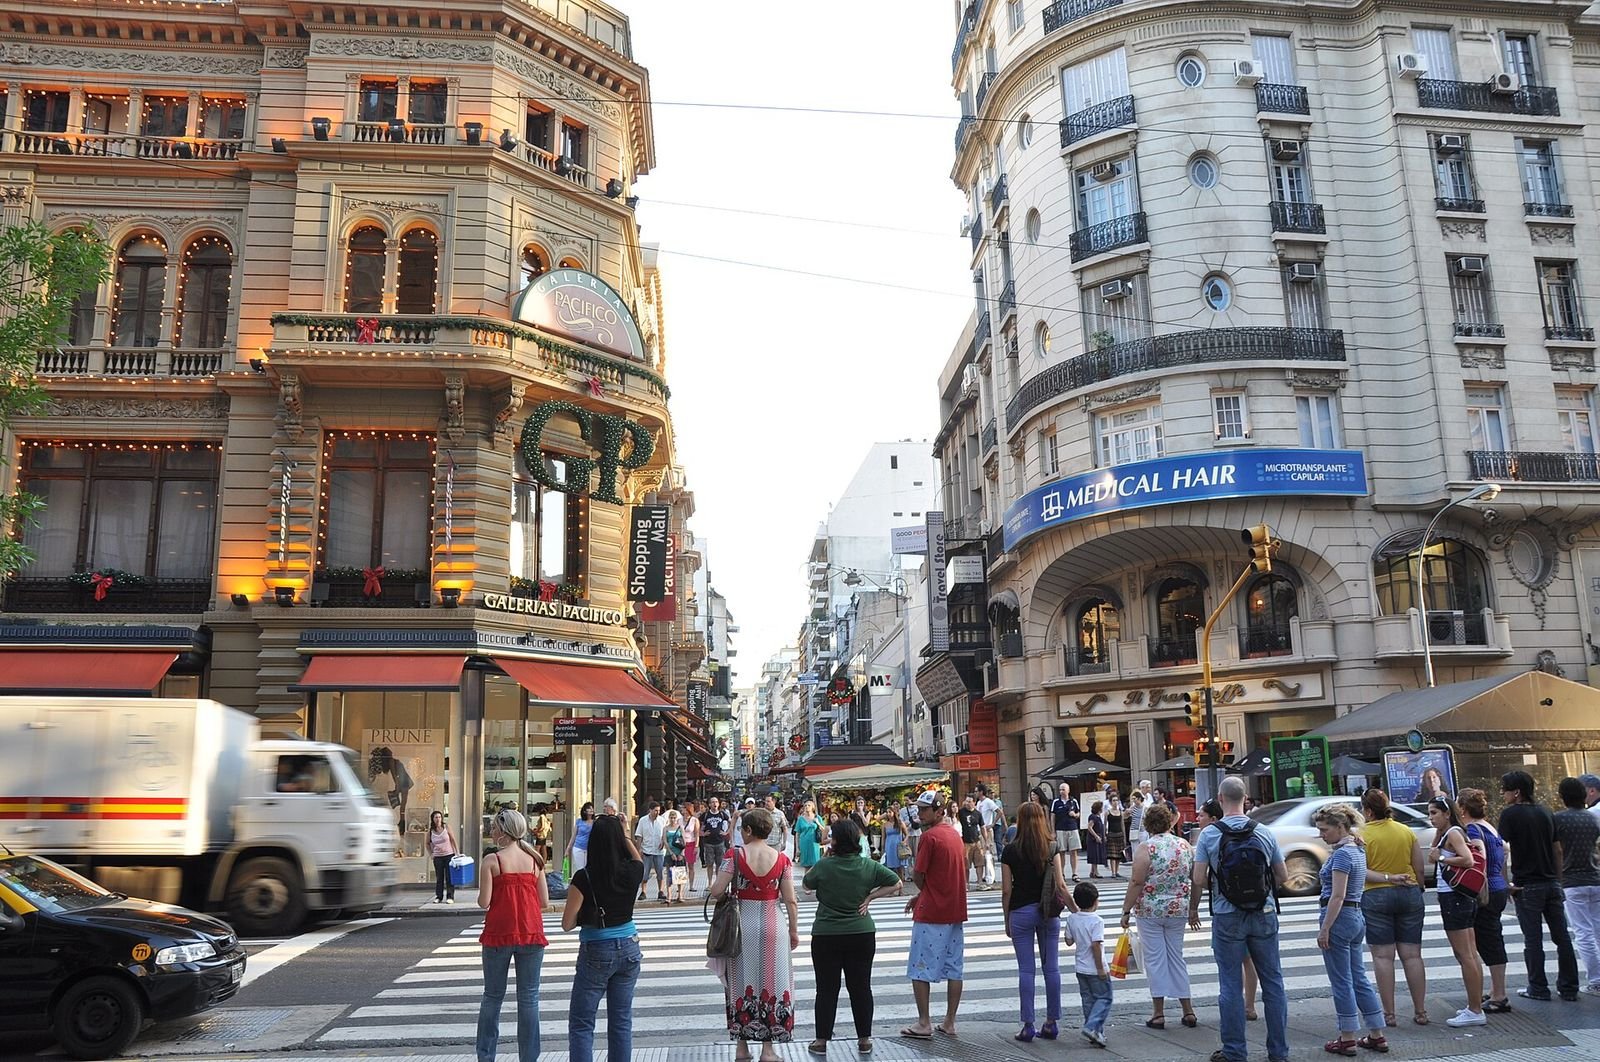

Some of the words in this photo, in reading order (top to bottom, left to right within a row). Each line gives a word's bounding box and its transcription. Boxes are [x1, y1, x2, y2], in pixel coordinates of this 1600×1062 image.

[537, 272, 631, 323] GALERIAS
[555, 291, 617, 325] PACIFICO
[1265, 464, 1347, 473] MICROTRANSPLANTE
[1291, 473, 1325, 481] CAPILAR
[1066, 473, 1163, 508] MEDICAL
[1172, 465, 1236, 490] HAIR
[651, 510, 666, 543] Mall
[896, 530, 912, 538] GOOD
[631, 519, 652, 595] Shopping
[935, 534, 944, 563] Store
[933, 568, 946, 603] Travel
[484, 593, 557, 617] GALERIAS
[562, 604, 622, 625] PACIFICO
[371, 727, 432, 743] PRÜNE
